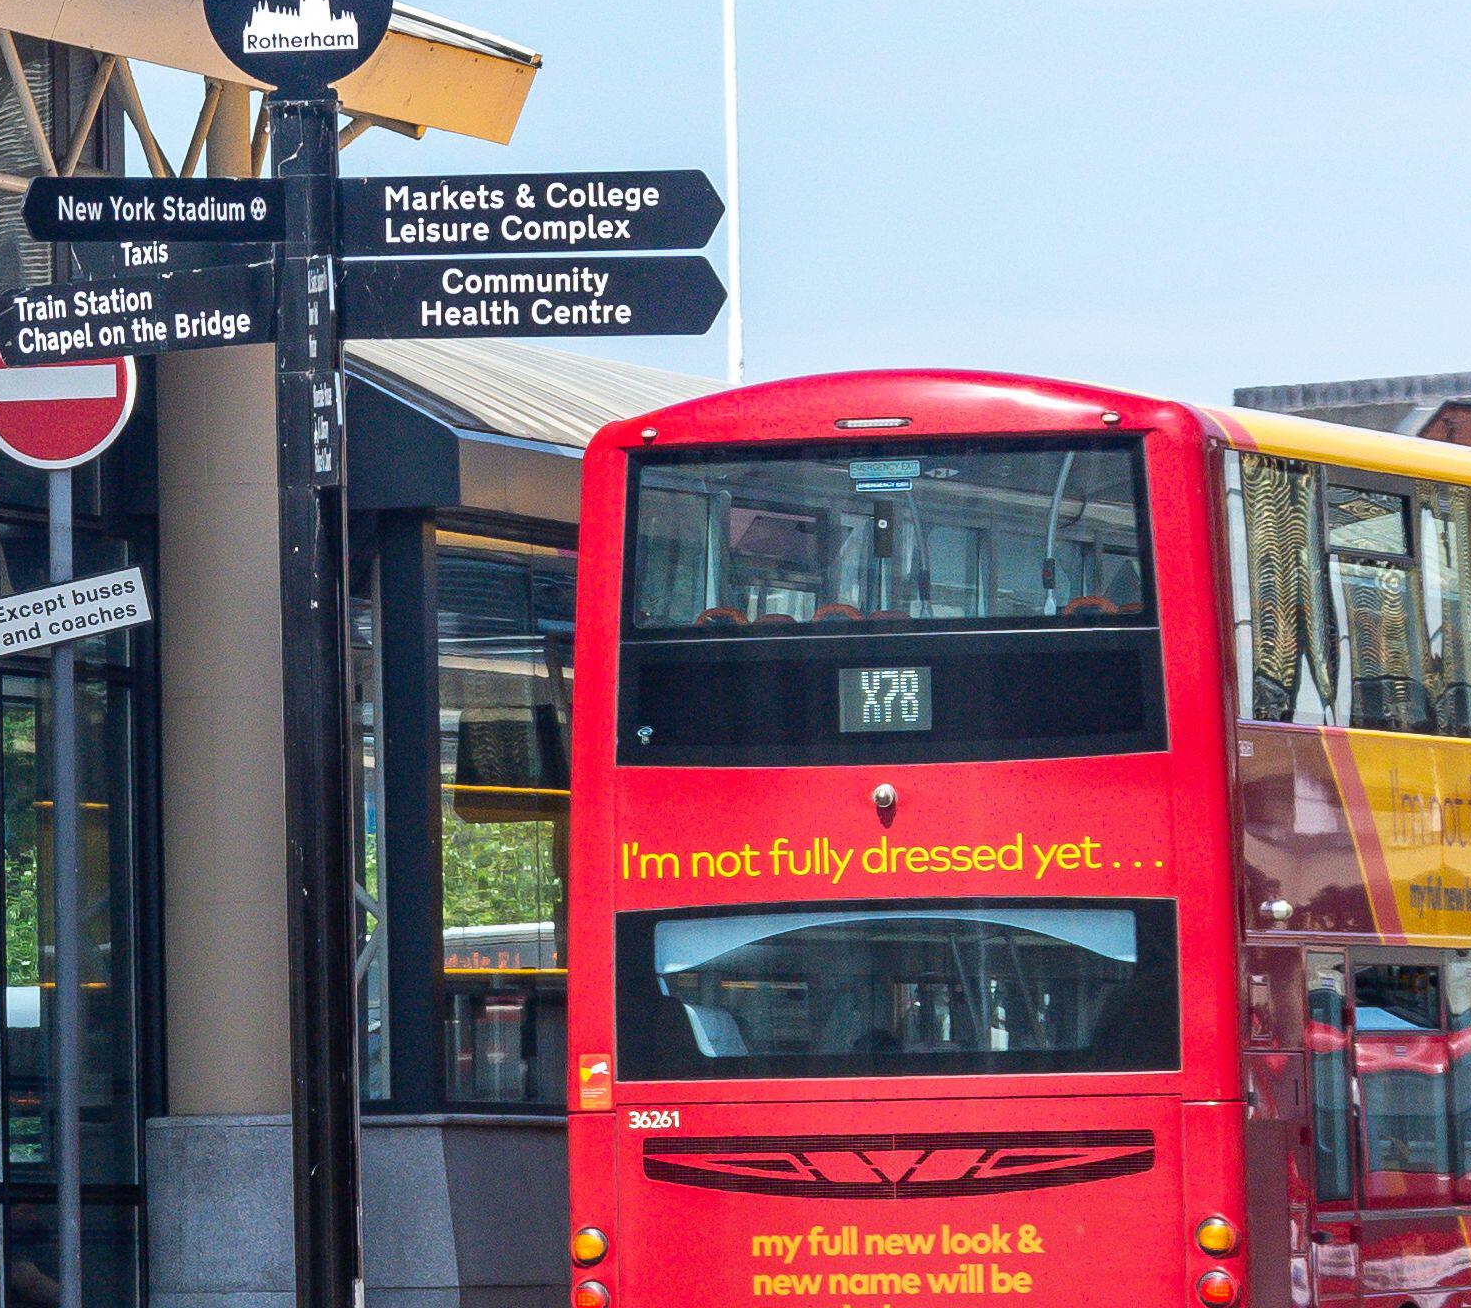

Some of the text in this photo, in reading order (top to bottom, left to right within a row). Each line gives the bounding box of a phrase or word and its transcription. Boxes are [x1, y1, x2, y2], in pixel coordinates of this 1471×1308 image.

[248, 32, 353, 49] Rotherham
[59, 196, 245, 221] New York Stadium
[385, 182, 659, 211] Markets & College
[386, 214, 630, 244] Leisure Complex
[121, 241, 168, 266] Taxis
[442, 267, 608, 297] Community
[14, 288, 152, 321] Train Station
[422, 299, 631, 326] Health Centre
[19, 310, 250, 355] Chapel on the Bridge
[72, 581, 135, 605] buses
[3, 599, 137, 646] and coaches
[861, 670, 919, 723] X78
[623, 842, 679, 879] I'm
[692, 844, 760, 877] not
[769, 838, 854, 884] fully
[862, 833, 1022, 873] dressed
[628, 1110, 680, 1129] 36261
[753, 1224, 1044, 1263] my full new look &
[754, 1264, 1032, 1295] new name will be
